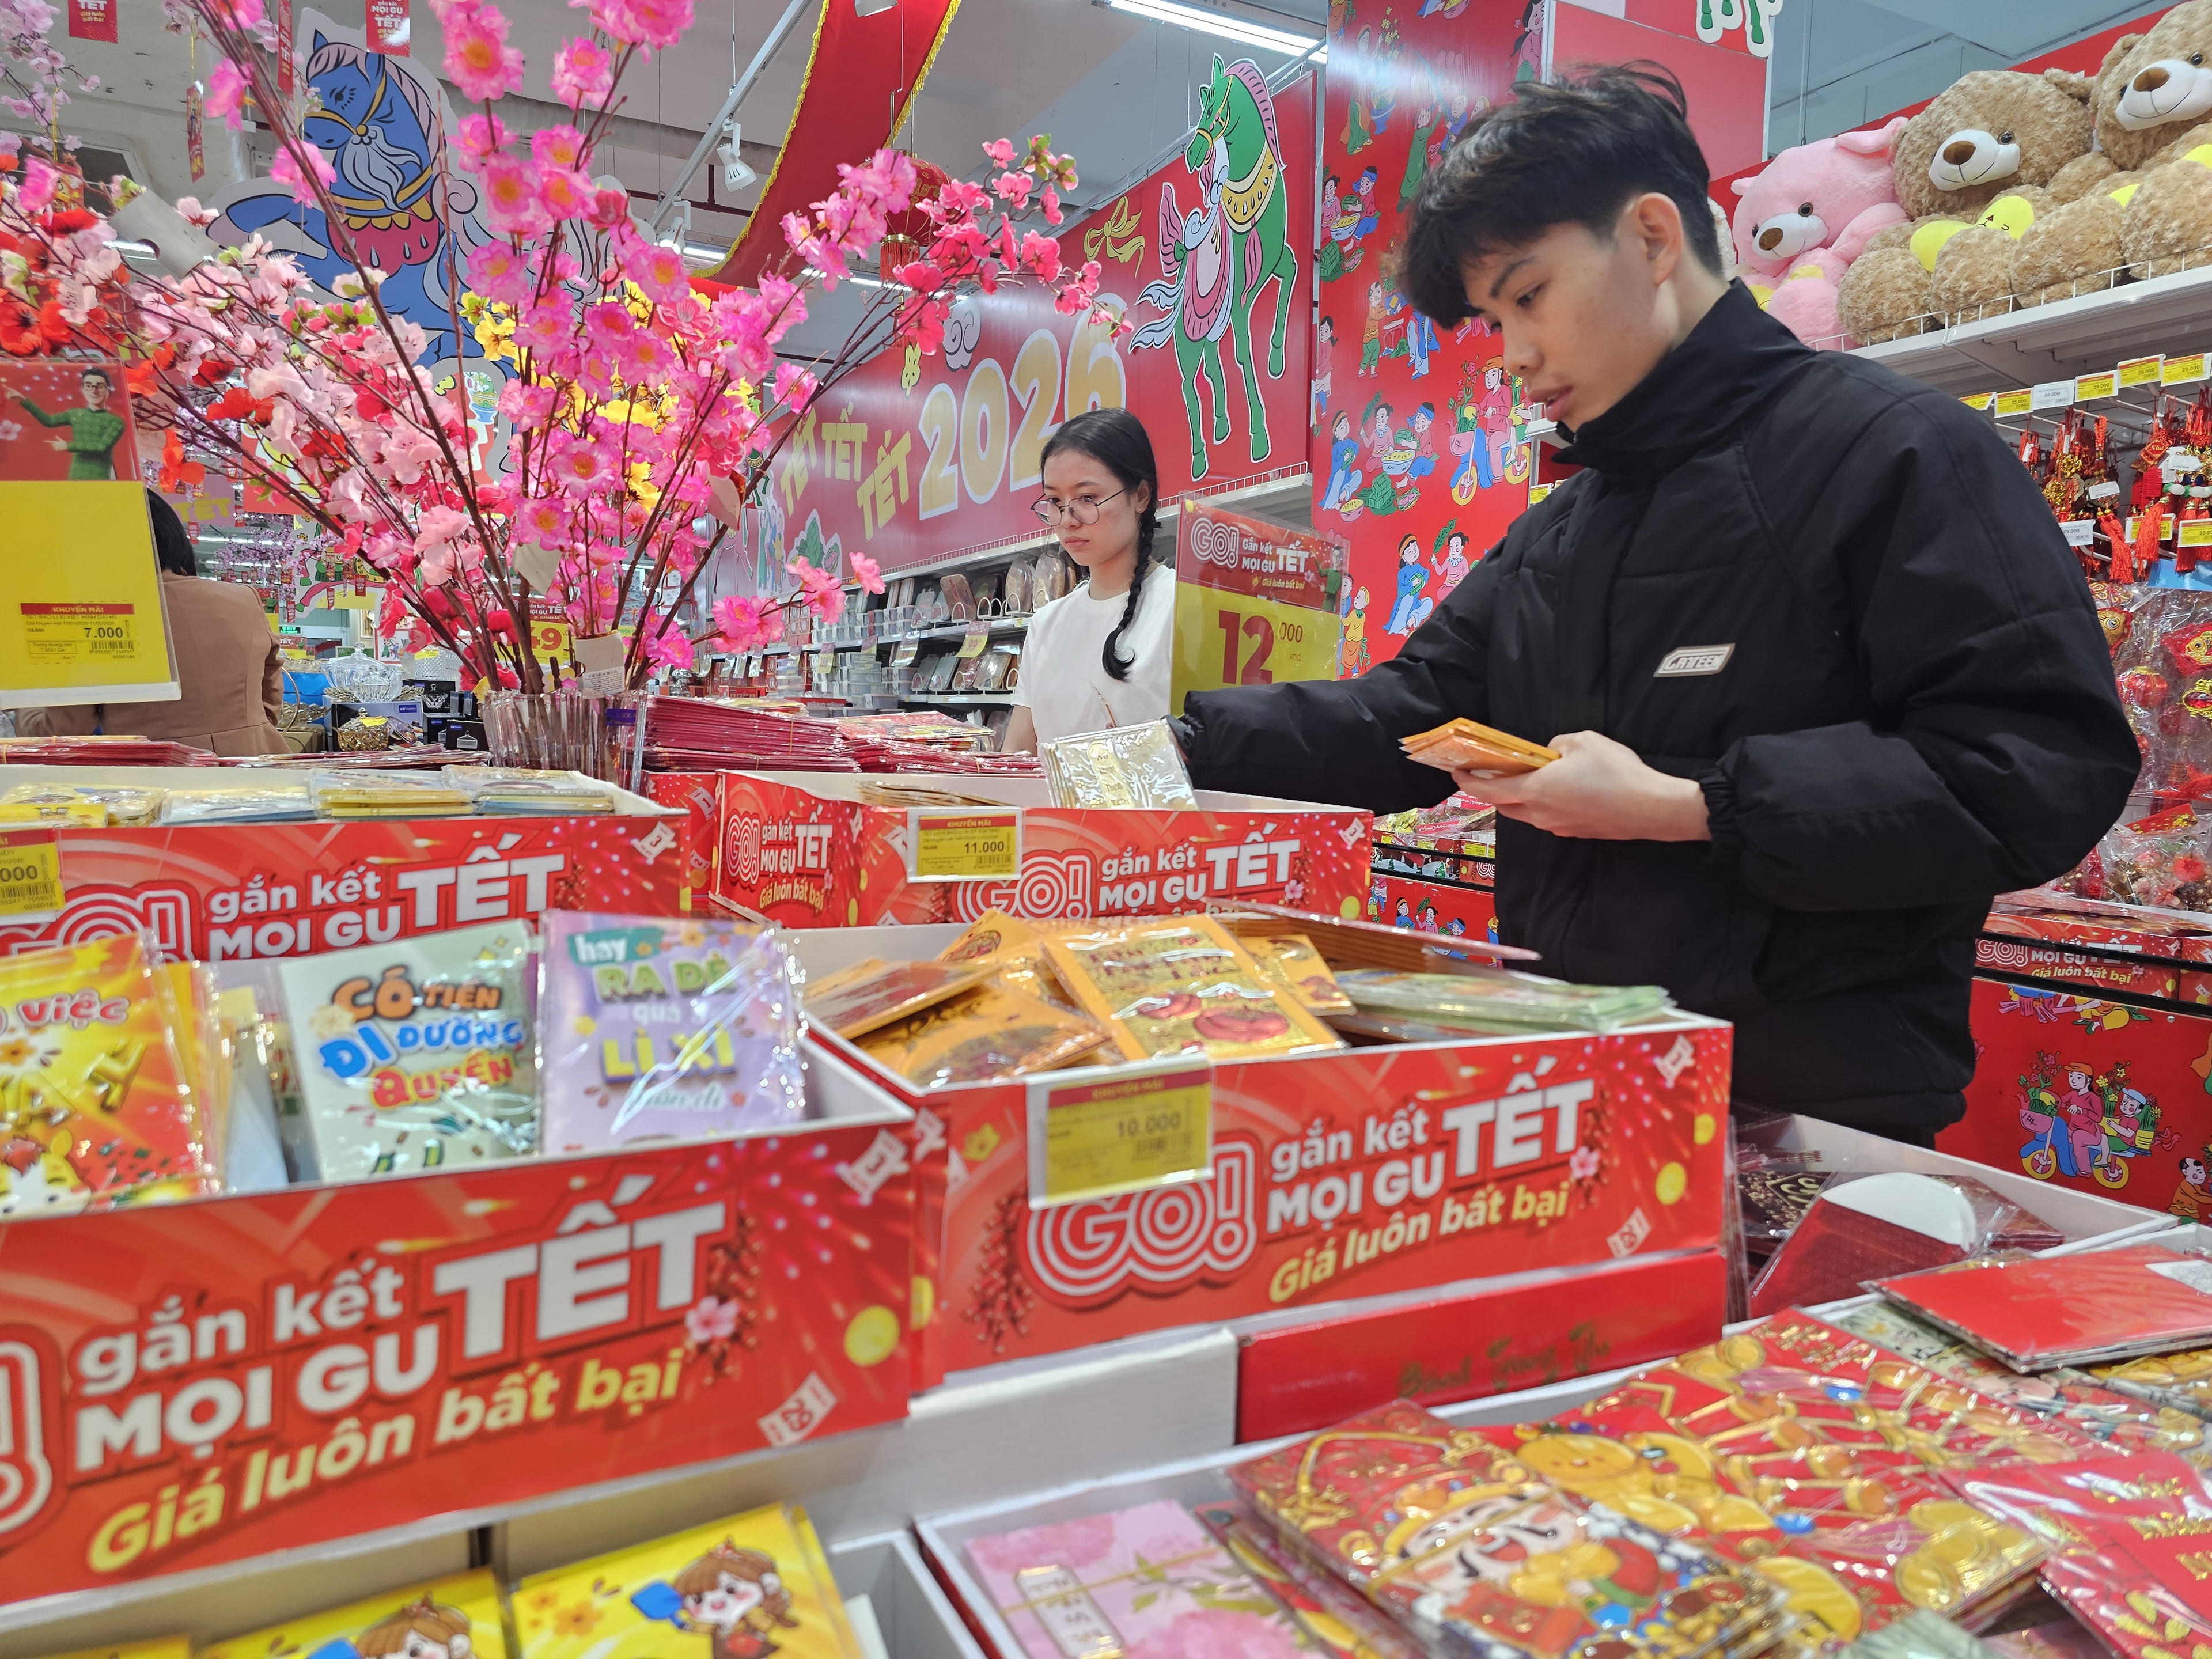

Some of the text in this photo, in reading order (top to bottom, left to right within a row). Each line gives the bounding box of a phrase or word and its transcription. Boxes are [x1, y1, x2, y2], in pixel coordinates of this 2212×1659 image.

[821, 400, 868, 482] TẾT
[857, 429, 912, 543] TẾT
[918, 292, 1127, 521] 2026
[1191, 517, 1240, 569] GO!
[1241, 556, 1275, 574] MỌI GU
[1276, 540, 1309, 573] TẾT
[84, 627, 123, 638] 7.000
[1219, 610, 1274, 685] 12
[725, 814, 761, 885] GO!
[762, 816, 793, 846] gắn kết
[794, 804, 833, 869] TẾT
[964, 841, 1005, 854] 11.000
[1205, 822, 1301, 891] TẾT
[397, 832, 565, 928] TẾT
[760, 847, 796, 878] MỌI GU
[956, 855, 1092, 921] GO!
[1101, 842, 1198, 881] gắn kết
[210, 866, 382, 923] gắn kết
[759, 877, 825, 914] Giá luôn bất bại
[1098, 873, 1207, 914] MỌI GU
[324, 906, 401, 949] GU
[576, 933, 628, 964] hay
[1976, 938, 2028, 968] GO!
[594, 964, 667, 1001] RA
[2031, 949, 2086, 965] MỌI GU
[2031, 966, 2131, 984] Giá luôn bất bại
[319, 1025, 392, 1078] ĐI
[1115, 1111, 1183, 1138] 10.000
[1441, 1055, 1596, 1178] TẾT
[1270, 1104, 1430, 1183] gắn kết
[1027, 1141, 1257, 1297] GO!
[1267, 1152, 1446, 1234] MỌI GU
[433, 1173, 727, 1360] TẾT
[1269, 1183, 1570, 1304] Giá luôn bất bại
[75, 1257, 404, 1396] gắn kết
[74, 1324, 440, 1461] MỌI GU
[85, 1346, 684, 1574] Giá luôn bất bại
